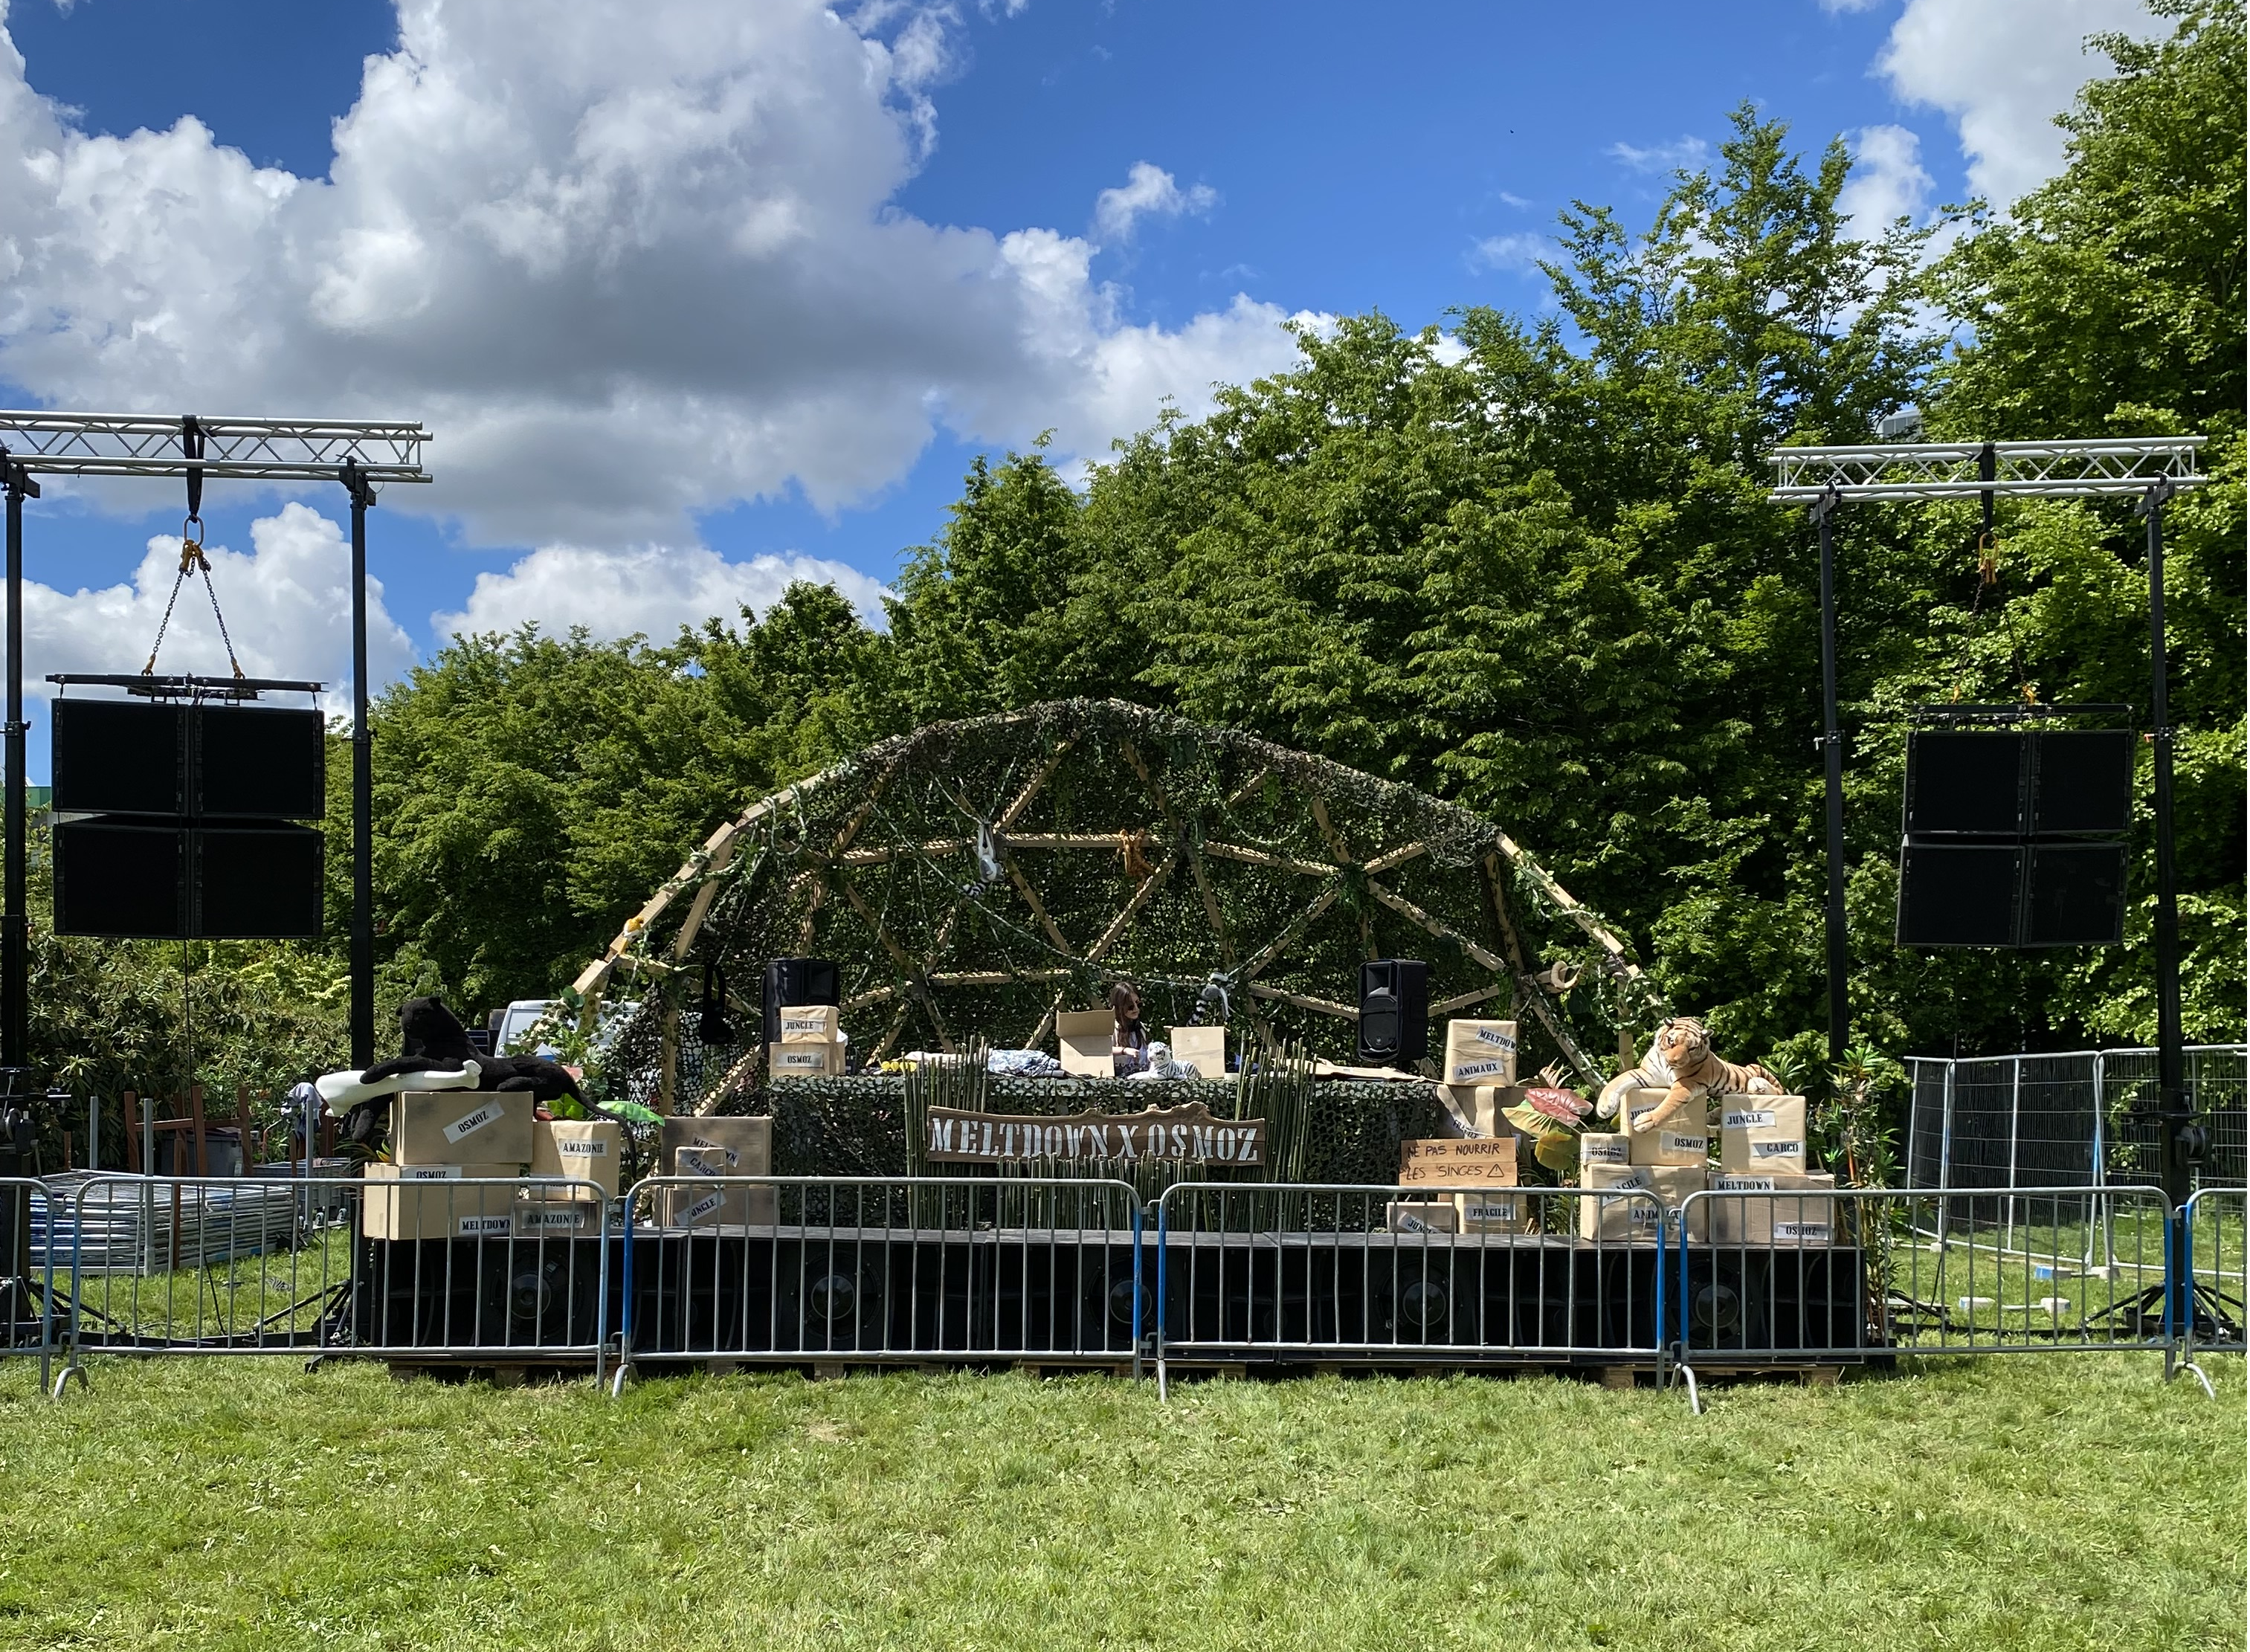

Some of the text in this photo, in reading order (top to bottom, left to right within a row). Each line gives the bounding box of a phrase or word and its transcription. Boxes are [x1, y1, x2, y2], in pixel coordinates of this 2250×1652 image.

[785, 1022, 814, 1030] JUNGLE
[787, 1056, 812, 1064] OSMOZ
[1458, 1063, 1498, 1077] ANIMAUX
[457, 1111, 489, 1133] OSMOZ
[1727, 1114, 1763, 1125] JUNGLE
[929, 1117, 1258, 1161] MELTDOWN X OSMOZ
[1674, 1138, 1704, 1149] OSMOZ
[563, 1143, 604, 1153] AMAZONIE
[1407, 1142, 1500, 1158] NE PAS NOURRIR
[1406, 1164, 1483, 1181] LES SINGES
[1718, 1181, 1770, 1190] MELTDOWN
